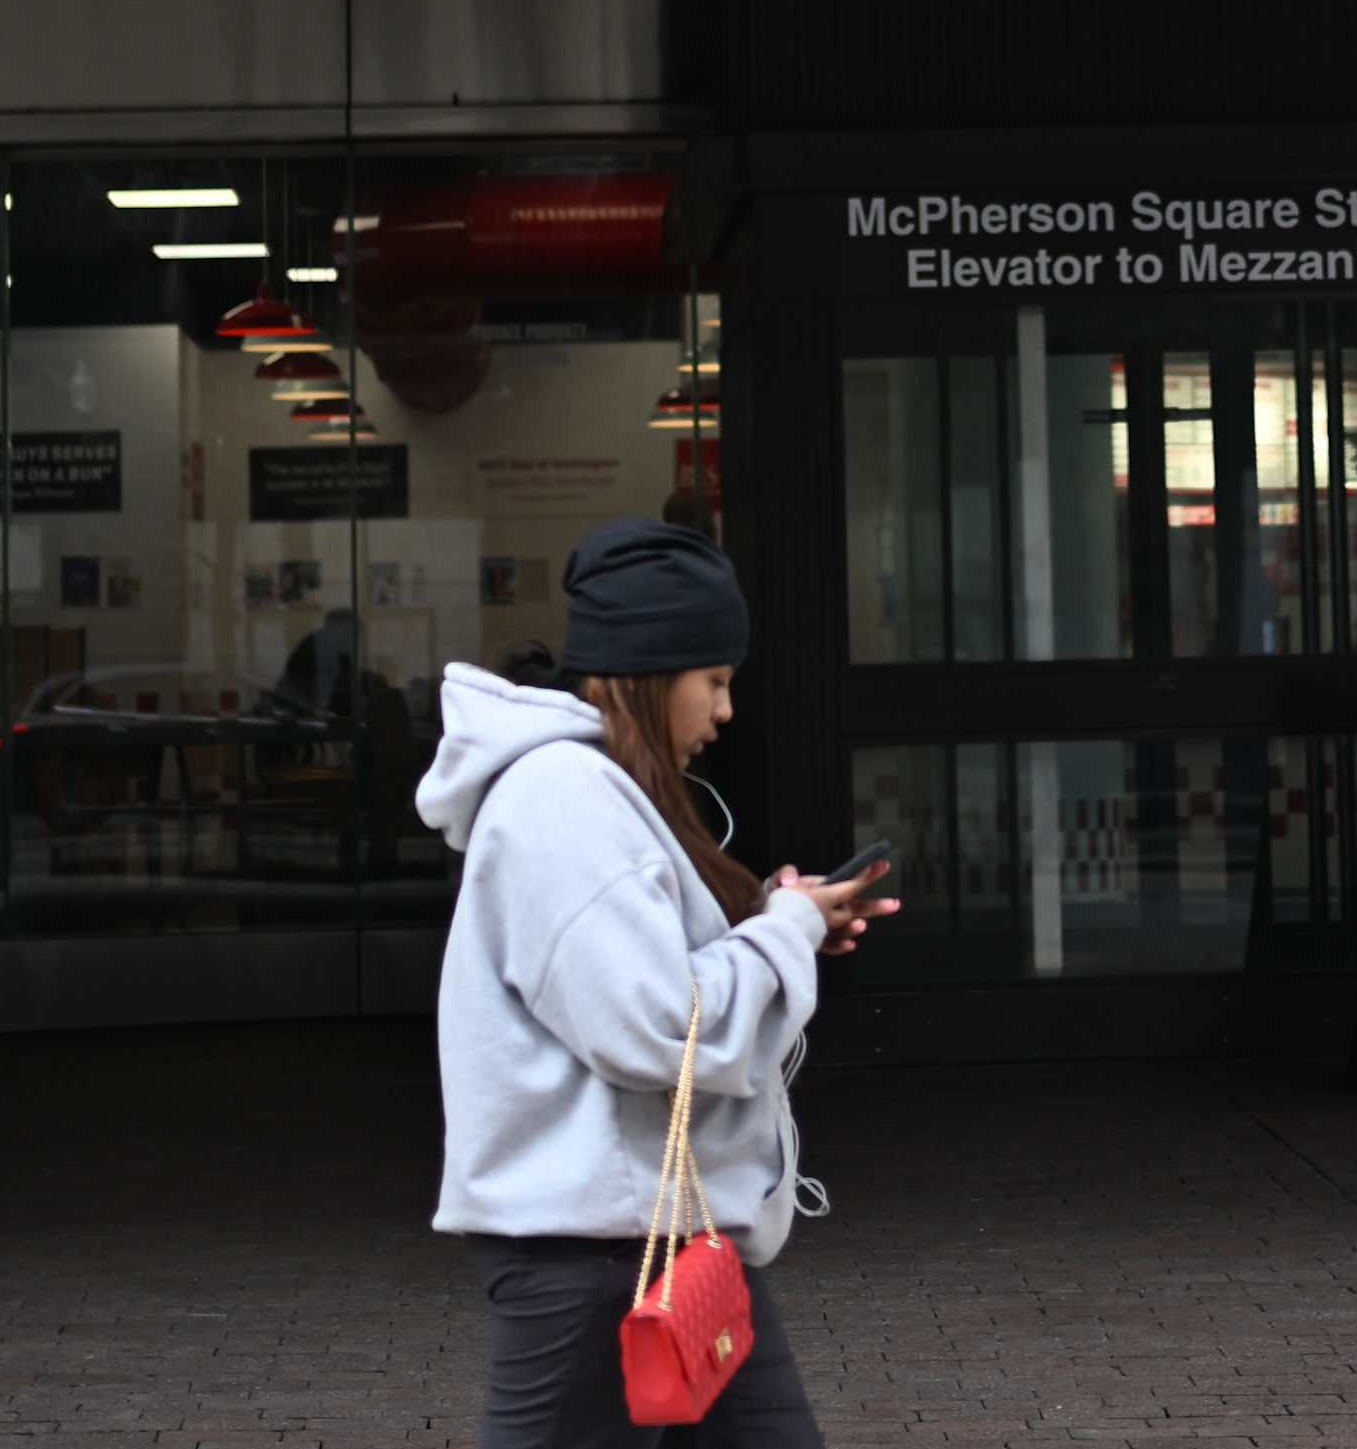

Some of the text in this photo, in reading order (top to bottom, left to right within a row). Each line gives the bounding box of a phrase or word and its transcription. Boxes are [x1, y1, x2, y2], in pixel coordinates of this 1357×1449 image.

[847, 196, 1115, 237] McPherson
[1131, 191, 1300, 238] Square
[906, 248, 1102, 288] Elevator
[1116, 246, 1163, 284] to
[51, 444, 117, 462] SERVES
